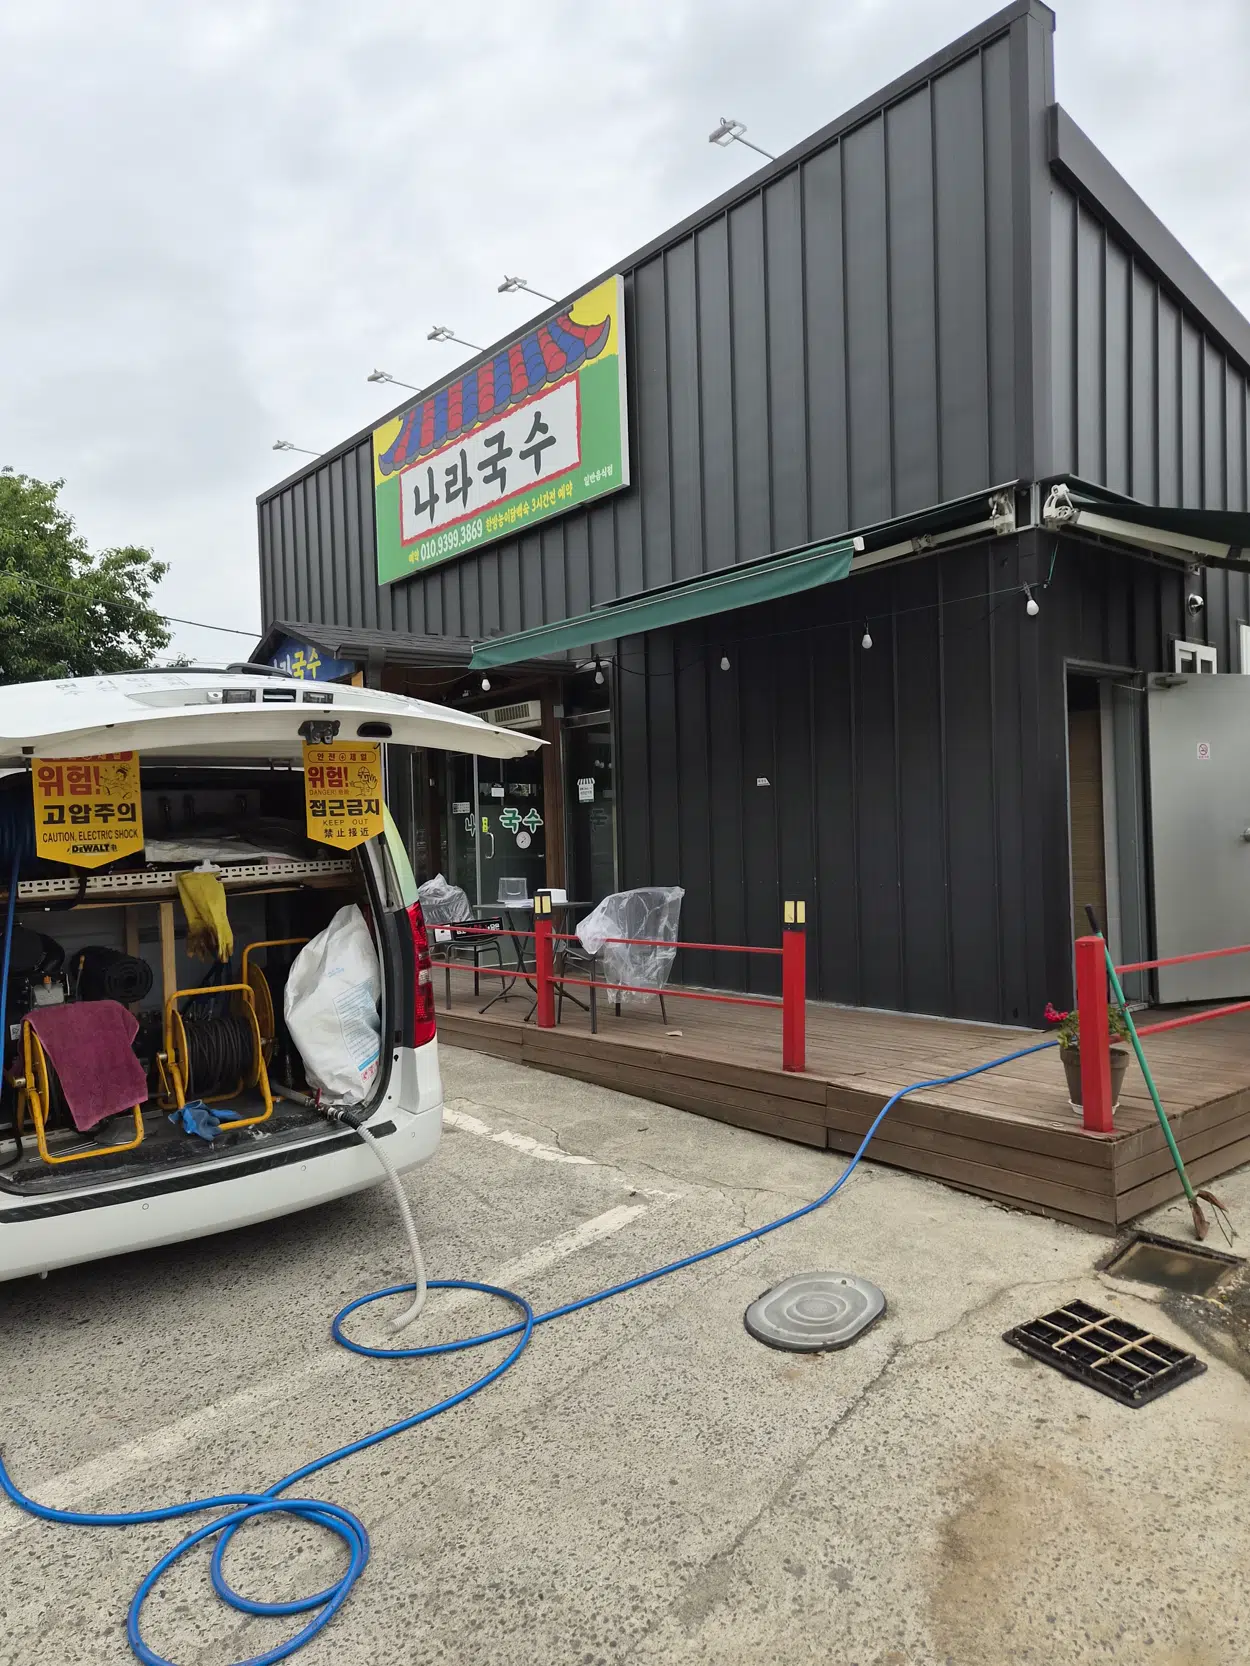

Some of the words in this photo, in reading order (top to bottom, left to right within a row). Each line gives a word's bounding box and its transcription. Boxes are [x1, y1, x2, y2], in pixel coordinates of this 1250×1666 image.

[413, 410, 557, 525] 나라국수
[583, 464, 614, 487] 일반음식점
[420, 518, 483, 561] 010.9399.3869
[531, 487, 556, 514] 3시간전
[558, 480, 573, 500] 예약
[38, 765, 101, 797] 위험!
[307, 766, 349, 789] 위험!
[43, 803, 137, 825] 고압주의
[309, 799, 380, 817] 접근금지
[322, 819, 345, 827] KEEP
[351, 818, 369, 826] OUT
[499, 807, 544, 834] 국수
[78, 829, 113, 841] ELECTRIC
[114, 828, 139, 840] SHOCK
